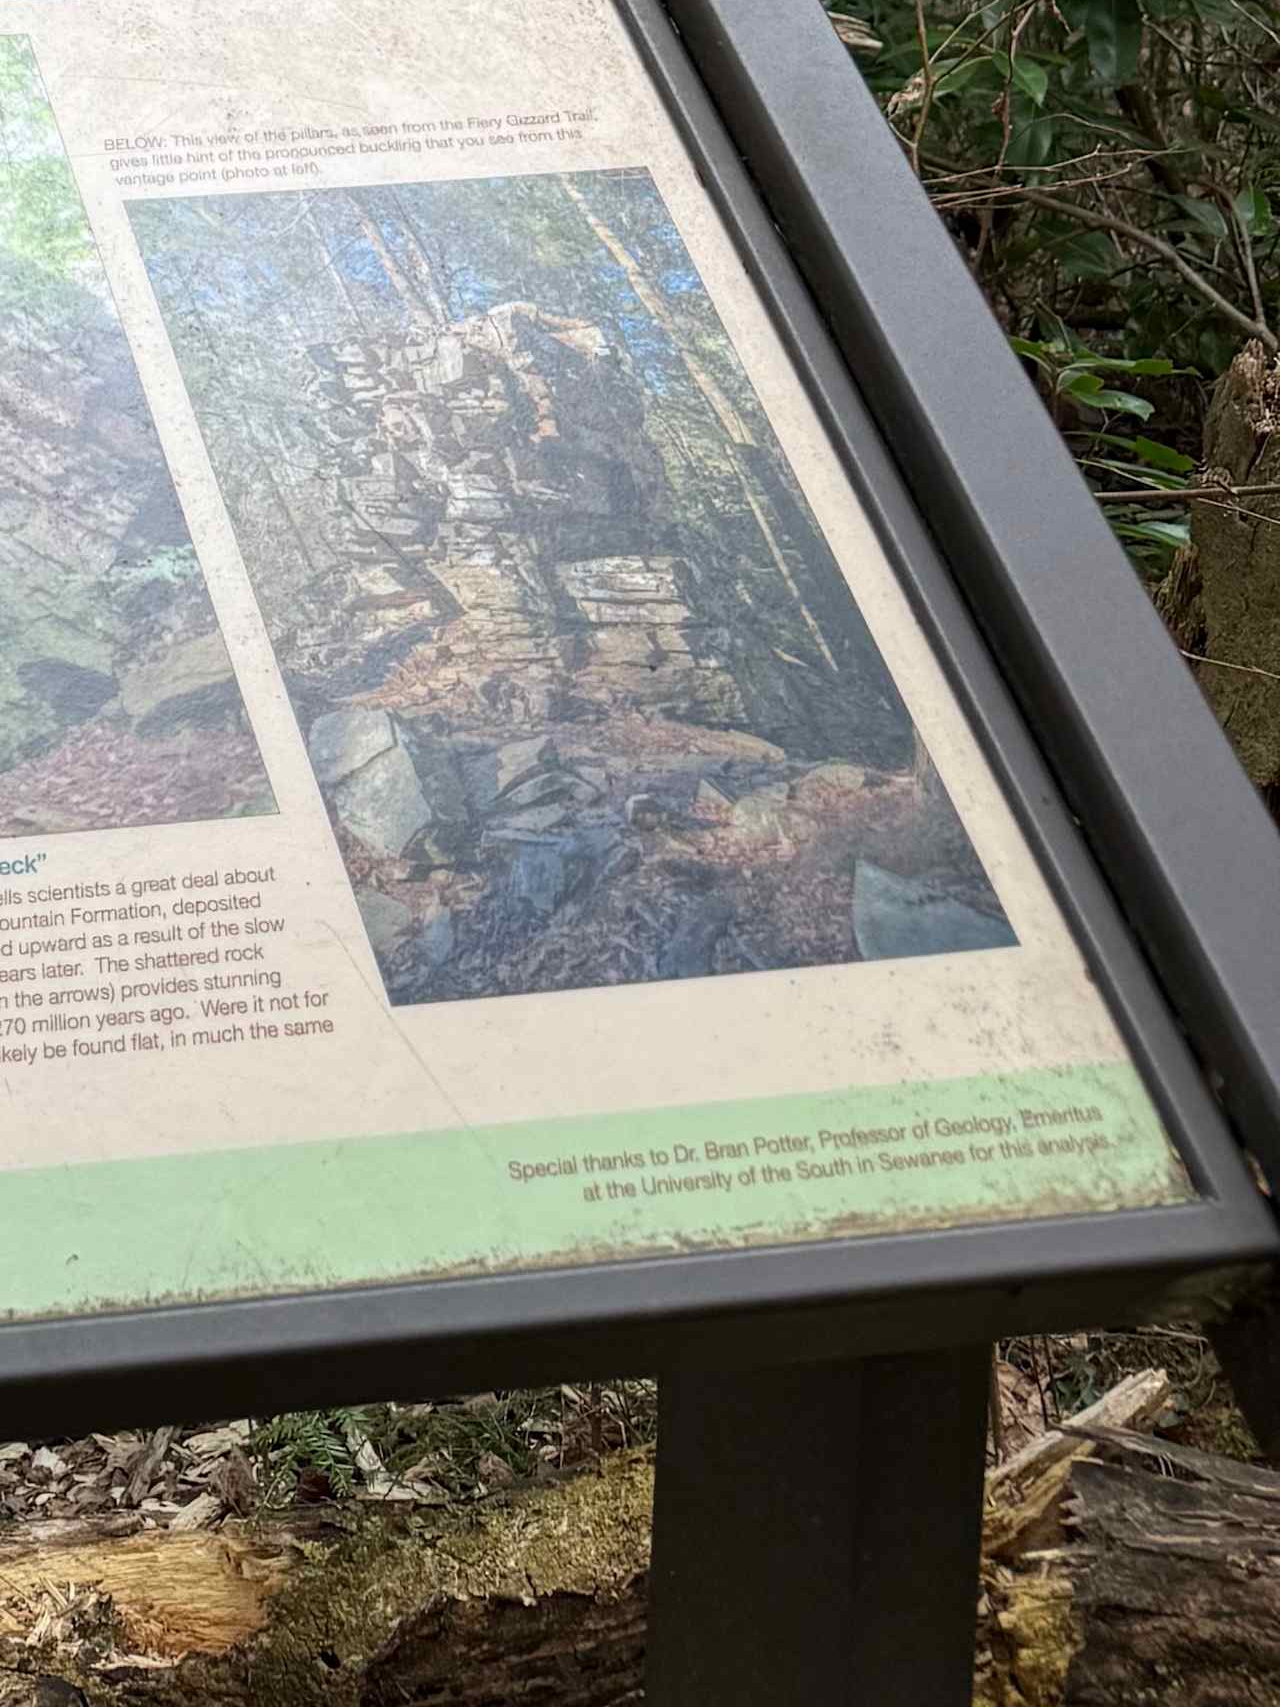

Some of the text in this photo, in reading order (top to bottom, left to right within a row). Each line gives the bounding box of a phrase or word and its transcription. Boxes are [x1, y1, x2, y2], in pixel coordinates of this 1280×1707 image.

[40, 961, 85, 980] later.
[93, 955, 129, 974] The
[134, 945, 219, 971] shattered
[224, 942, 265, 962] rock
[508, 1154, 578, 1184] Special
[581, 1149, 646, 1173] thanks
[648, 1148, 669, 1166] to
[703, 1142, 749, 1160] Bran
[817, 1126, 906, 1148] Professor
[912, 1119, 930, 1139] of
